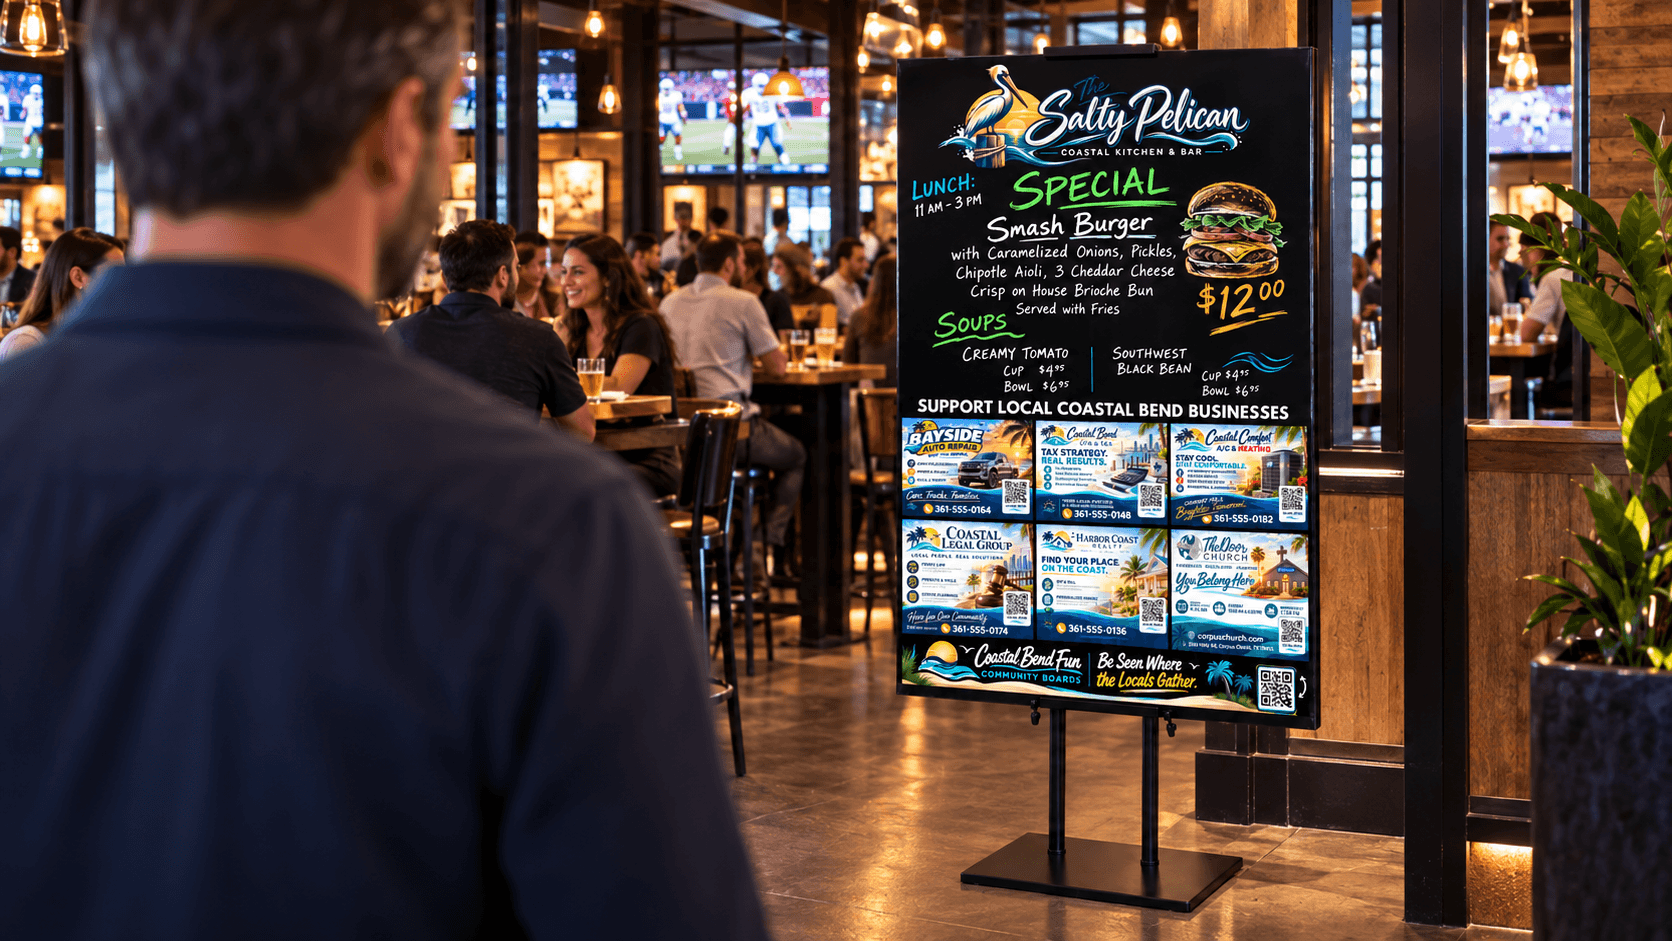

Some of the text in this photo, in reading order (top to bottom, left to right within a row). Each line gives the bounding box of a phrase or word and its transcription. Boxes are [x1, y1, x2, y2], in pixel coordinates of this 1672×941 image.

[1025, 85, 1249, 147] Salty Pelican
[1061, 148, 1202, 156] COASTAL KITCHEN & BAR
[912, 173, 975, 201] LUNCH:
[1009, 167, 1170, 211] SPECIAL
[914, 204, 925, 217] 11
[927, 201, 943, 215] AM
[955, 196, 964, 210] 3
[966, 193, 982, 207] PM
[987, 212, 1153, 243] Smash Burger
[951, 243, 1177, 261] with Caramelized Onions, Pickles,
[955, 262, 1175, 282] Chipotle Aioli, 3 Cheddar Cheese
[970, 283, 1154, 300] Crisp on House Brioche Bun
[1016, 302, 1120, 315] Served with Fries
[962, 346, 1069, 361] CREAMY TOMATO
[1112, 346, 1188, 360] SOUTHWEST
[1117, 362, 1192, 375] BLACK BEAN
[917, 398, 1290, 420] SUPPORT LOCAL COASTAL BEND BUSINESSES
[908, 427, 984, 445] BAYSIDE
[922, 443, 946, 453] AUTO
[1041, 448, 1108, 457] TAX STRATEGY.
[1066, 457, 1107, 466] RESULTS.
[946, 526, 1001, 540] COASTAL
[1076, 533, 1139, 544] HARBOR COAST
[942, 537, 1013, 551] LEGAL GROUP
[1041, 556, 1120, 566] FIND YOUR PLACE
[1203, 553, 1248, 561] CHURCH
[1041, 564, 1109, 574] ON THE COAST.
[974, 643, 1083, 672] Coastal Bend Fun
[1097, 652, 1182, 671] Be Seen Where
[981, 670, 1081, 684] COMMUNITY BOARDS
[1096, 671, 1198, 689] the Locals Gather.
